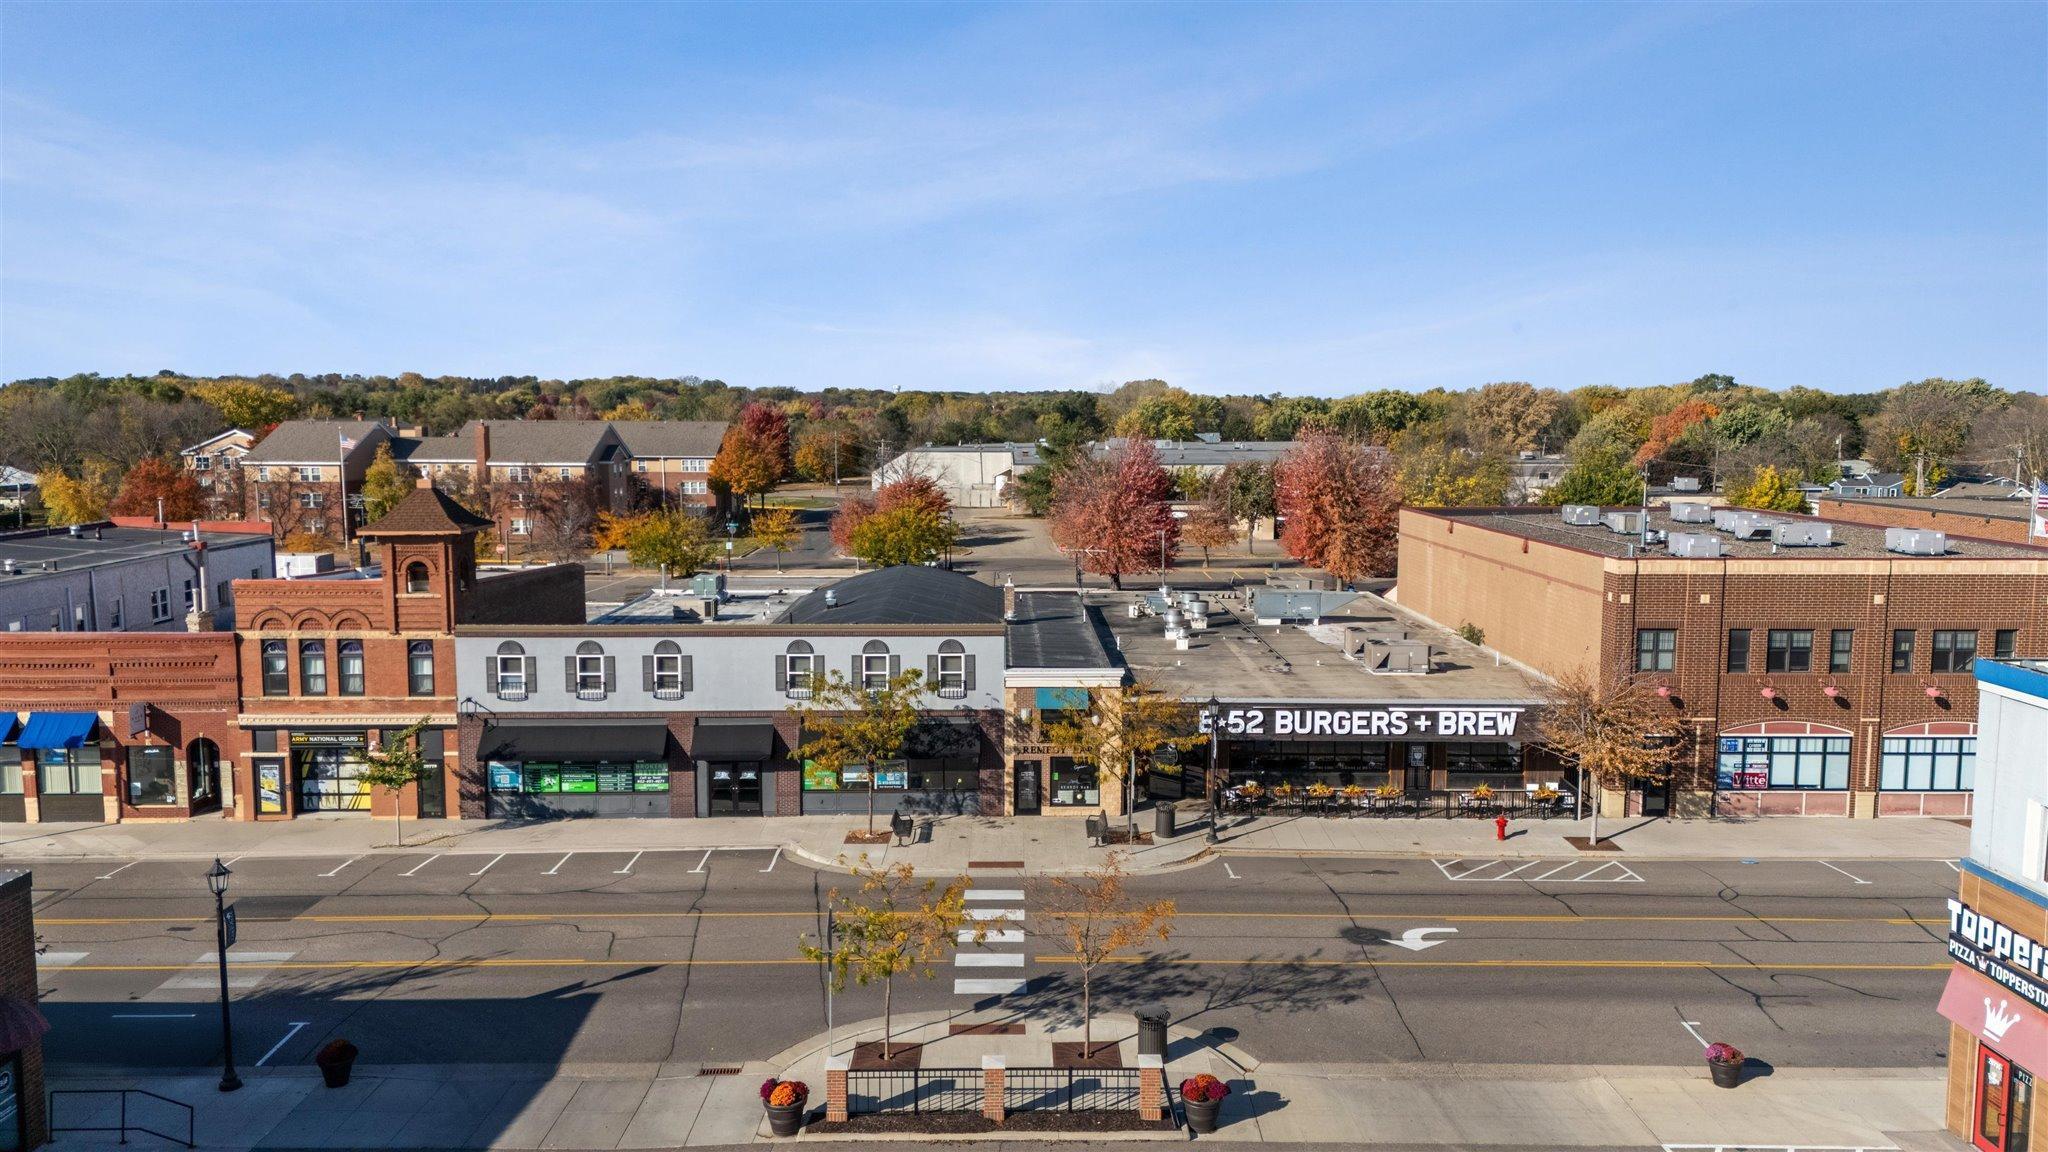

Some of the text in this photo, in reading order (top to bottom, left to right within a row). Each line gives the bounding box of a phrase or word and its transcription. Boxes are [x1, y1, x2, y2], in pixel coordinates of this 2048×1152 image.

[1275, 710, 1409, 736] BURGERS
[1414, 714, 1432, 732] +
[1438, 711, 1517, 736] BREW
[1949, 938, 1977, 966] PIZZA
